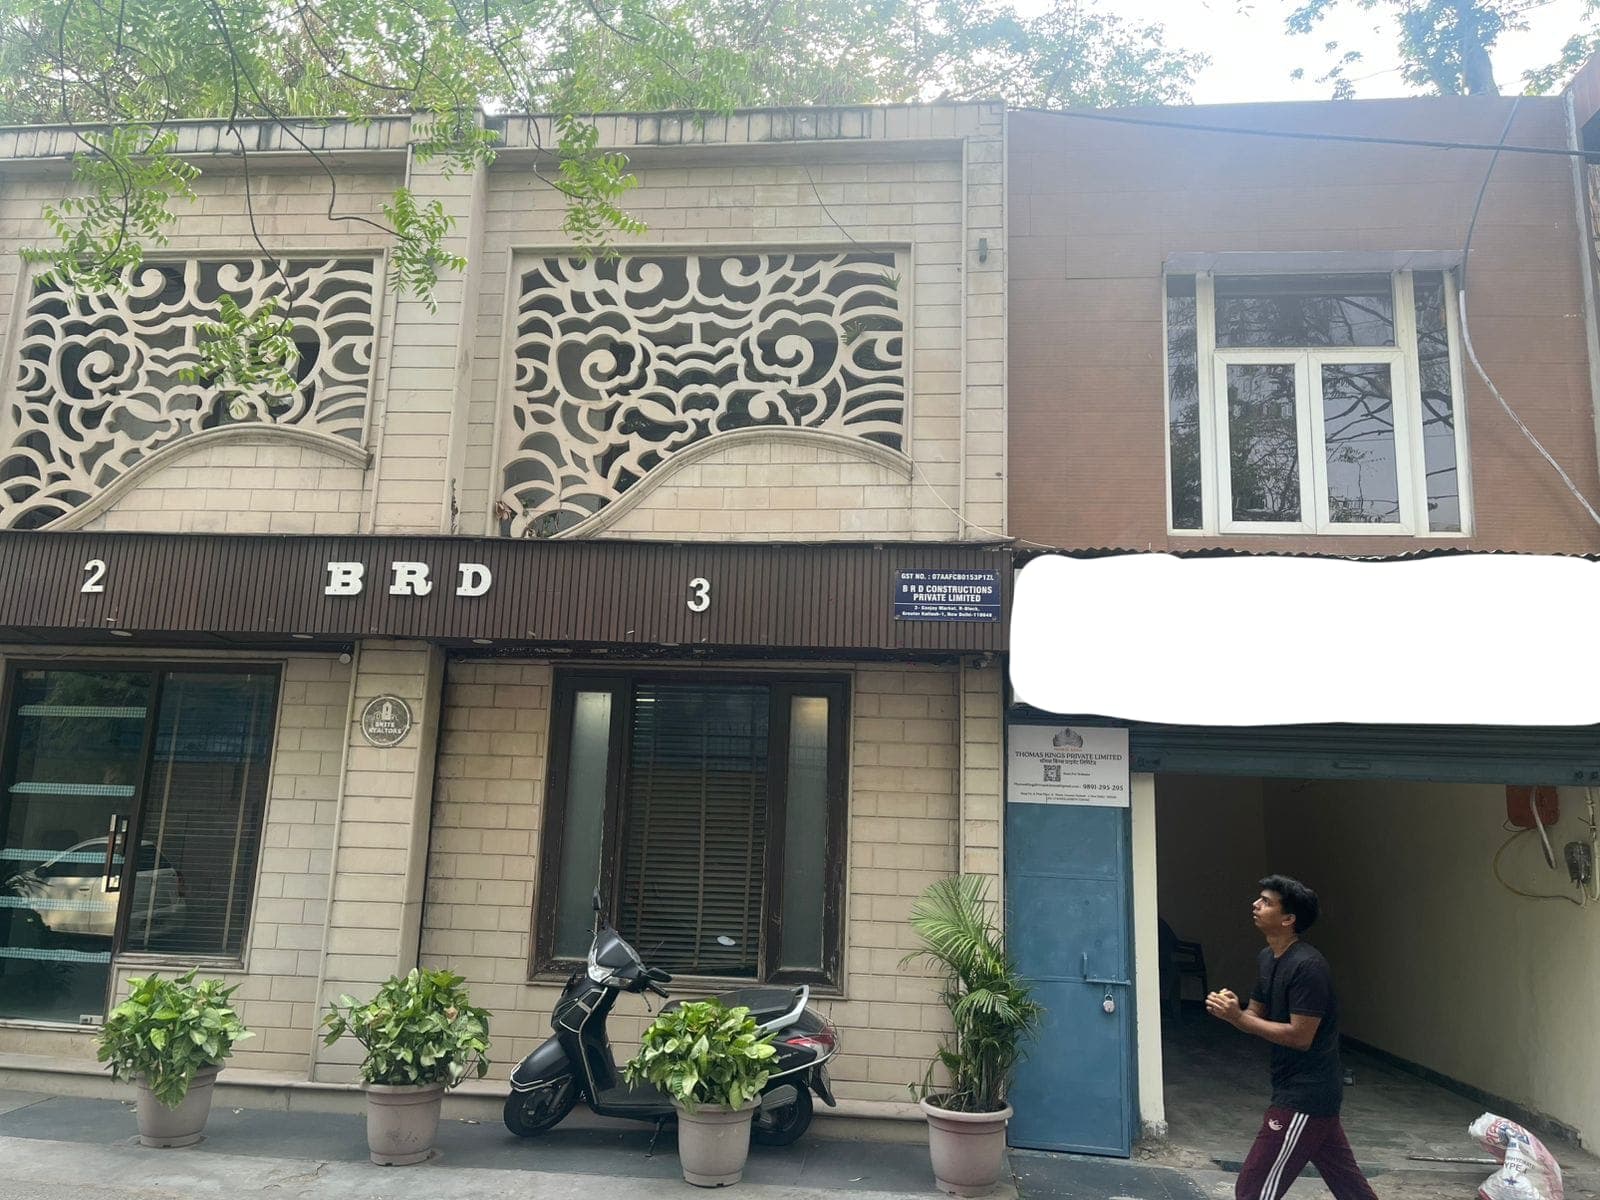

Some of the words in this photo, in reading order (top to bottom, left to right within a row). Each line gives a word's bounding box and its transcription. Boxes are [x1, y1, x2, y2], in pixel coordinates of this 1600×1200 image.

[80, 559, 105, 593] 2
[324, 561, 364, 596] B
[388, 561, 433, 597] R
[455, 563, 492, 598] D
[686, 577, 711, 613] 3
[913, 593, 946, 601] PRIVATE
[948, 594, 981, 602] LIMITED
[926, 585, 993, 594] CONSTRUCTIONS
[1015, 751, 1044, 759] THOMAS
